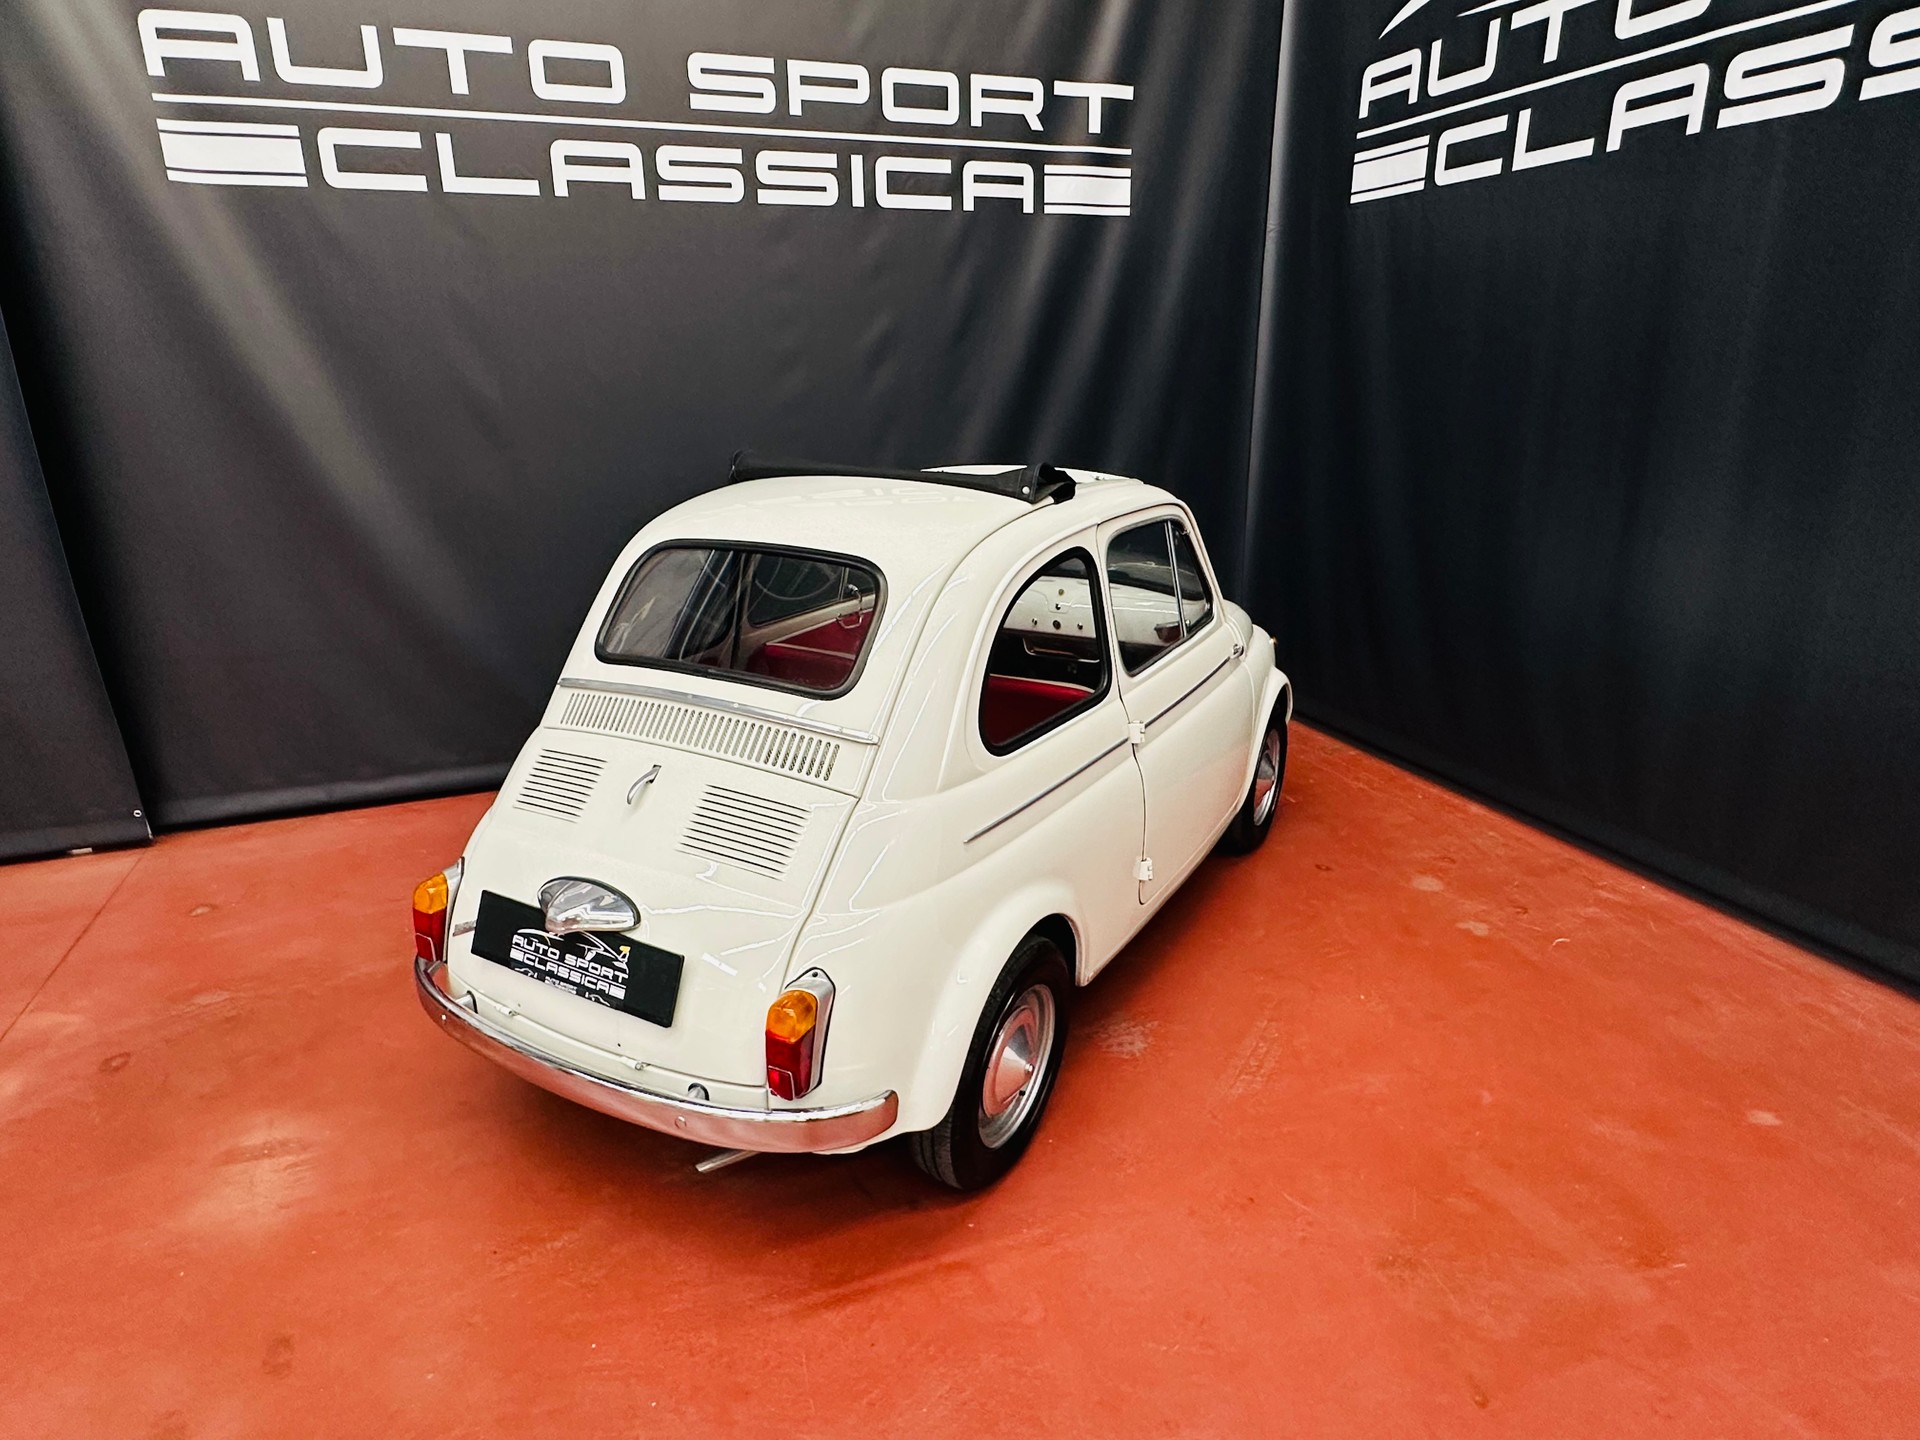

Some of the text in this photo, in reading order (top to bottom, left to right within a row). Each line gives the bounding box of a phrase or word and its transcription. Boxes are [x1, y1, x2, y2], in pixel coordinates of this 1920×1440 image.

[138, 9, 1135, 134] AUTO SPORT
[316, 126, 1035, 214] CLASSICA
[512, 934, 629, 983] AUTO SPORT
[523, 952, 610, 994] CLASSICA
